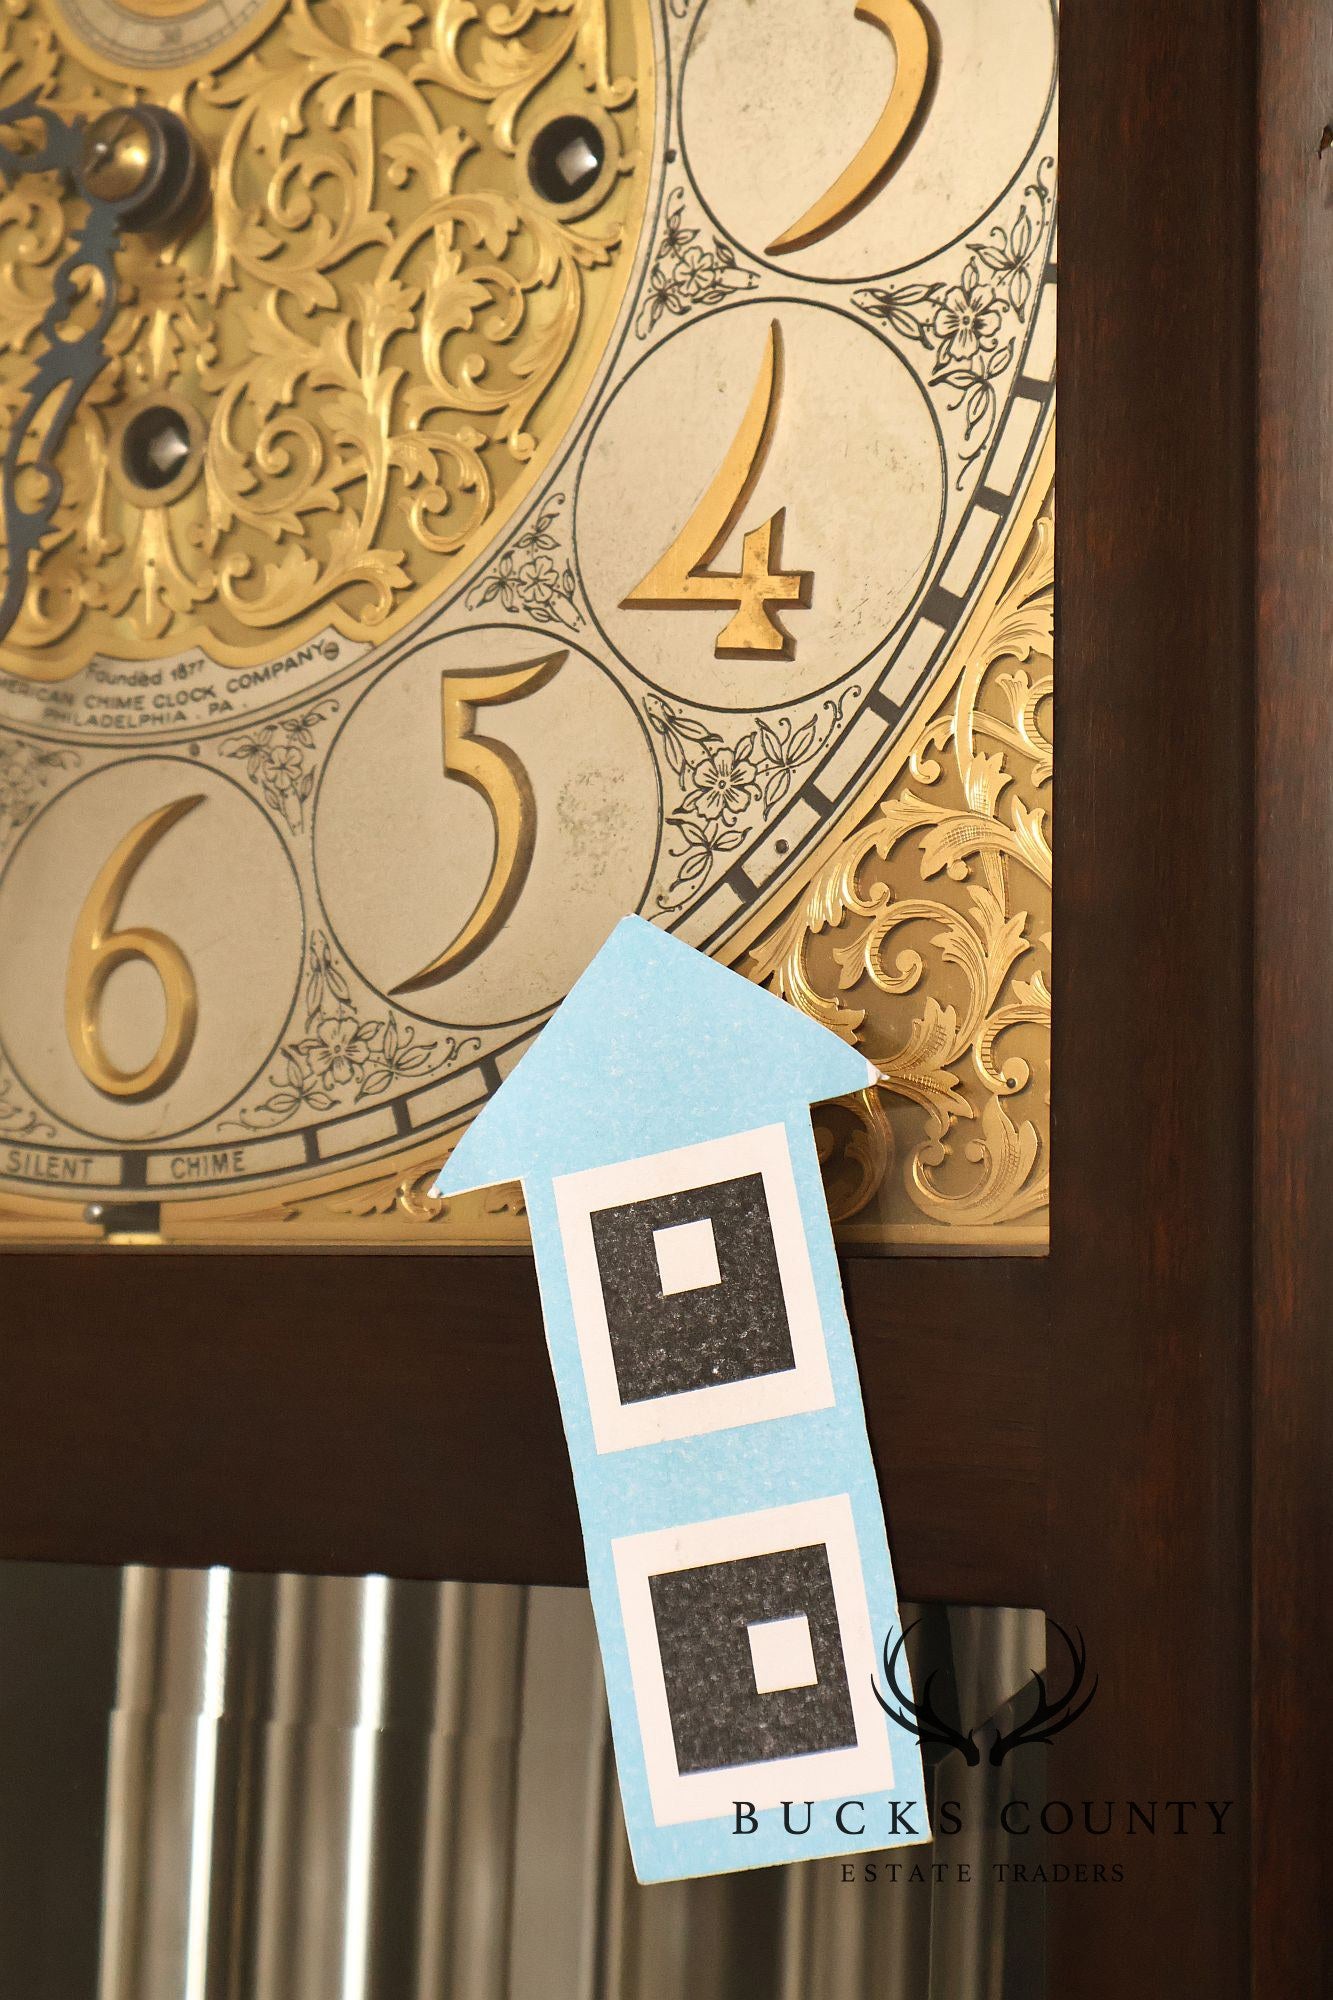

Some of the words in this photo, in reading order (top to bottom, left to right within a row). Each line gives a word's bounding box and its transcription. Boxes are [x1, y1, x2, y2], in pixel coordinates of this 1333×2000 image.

[617, 318, 814, 661] 4
[83, 694, 145, 710] CHIME
[152, 684, 217, 710] CLOCK
[225, 638, 326, 693] COMPANY
[86, 660, 162, 687] Founded
[169, 658, 206, 682] 1877
[42, 706, 187, 729] PHILADELPHIA
[388, 648, 570, 995] 5
[65, 793, 208, 1100] 6
[6, 1149, 94, 1180] SILENT
[170, 1150, 245, 1179] CHIME
